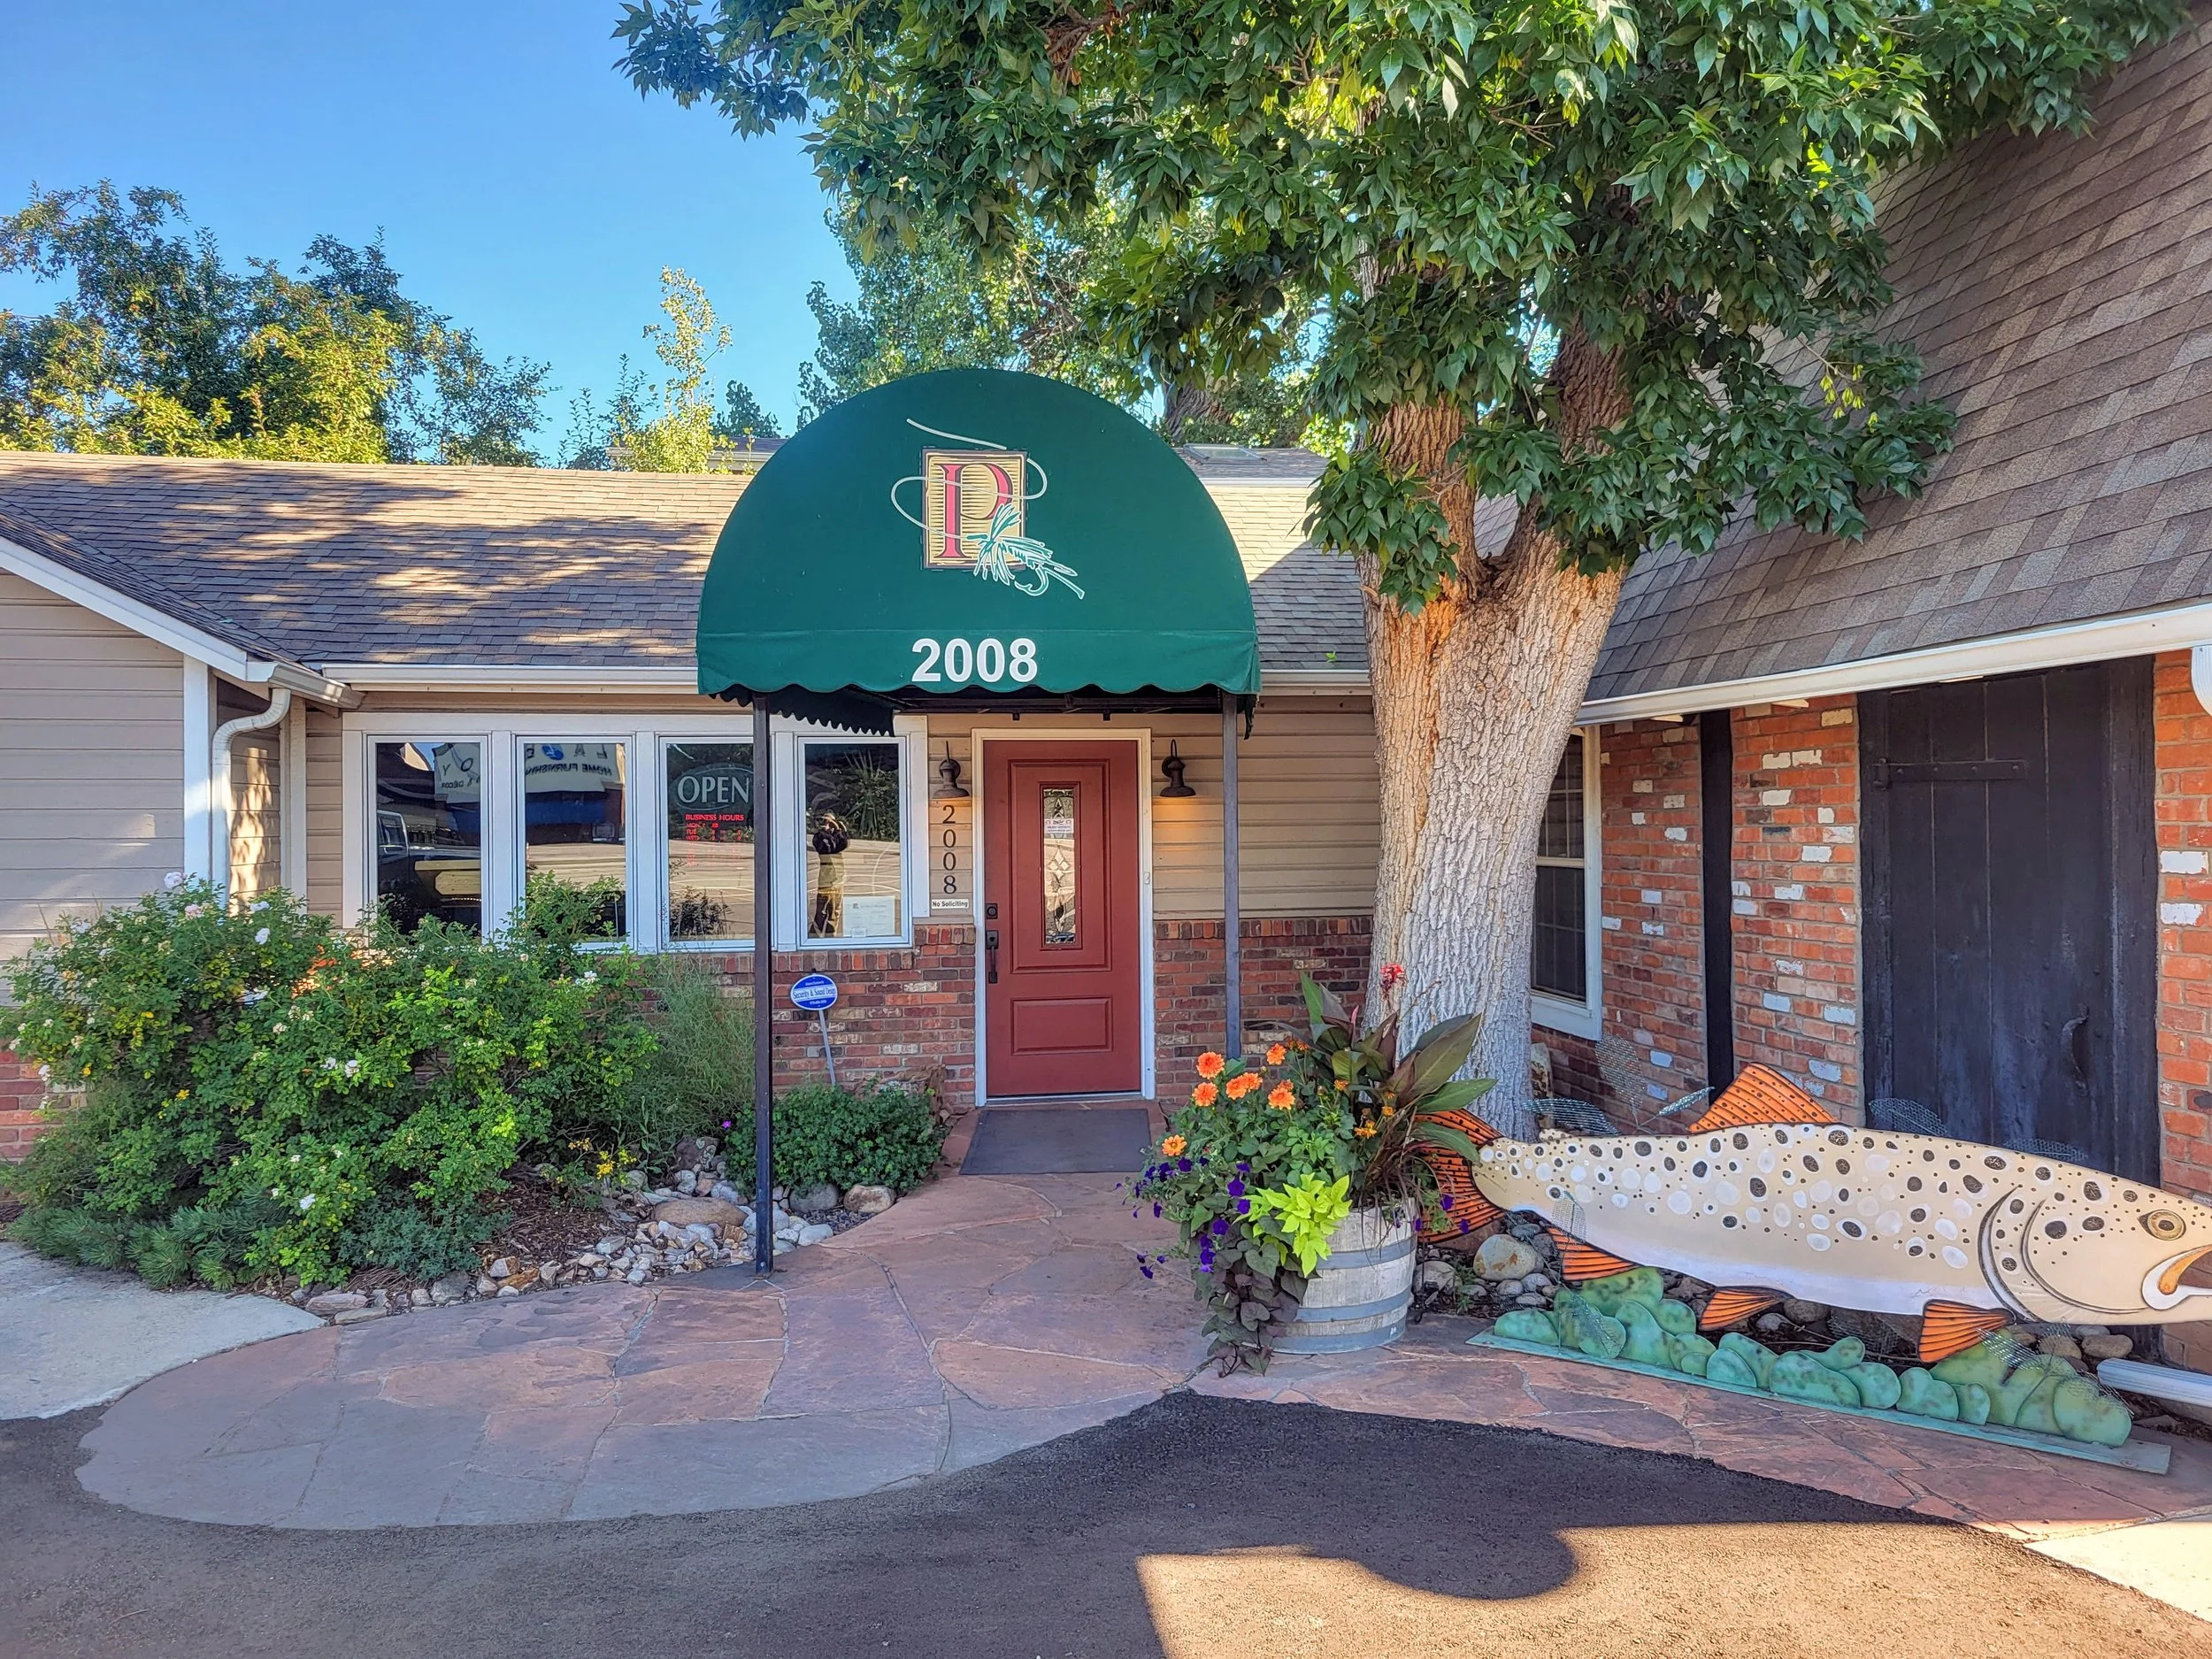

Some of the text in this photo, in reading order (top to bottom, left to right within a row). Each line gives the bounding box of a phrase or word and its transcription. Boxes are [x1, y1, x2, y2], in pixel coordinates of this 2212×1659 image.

[933, 462, 1013, 558] P
[911, 638, 1038, 683] 2008
[677, 775, 749, 803] OPEN
[942, 804, 956, 895] 2008
[941, 900, 968, 909] Soliciting
